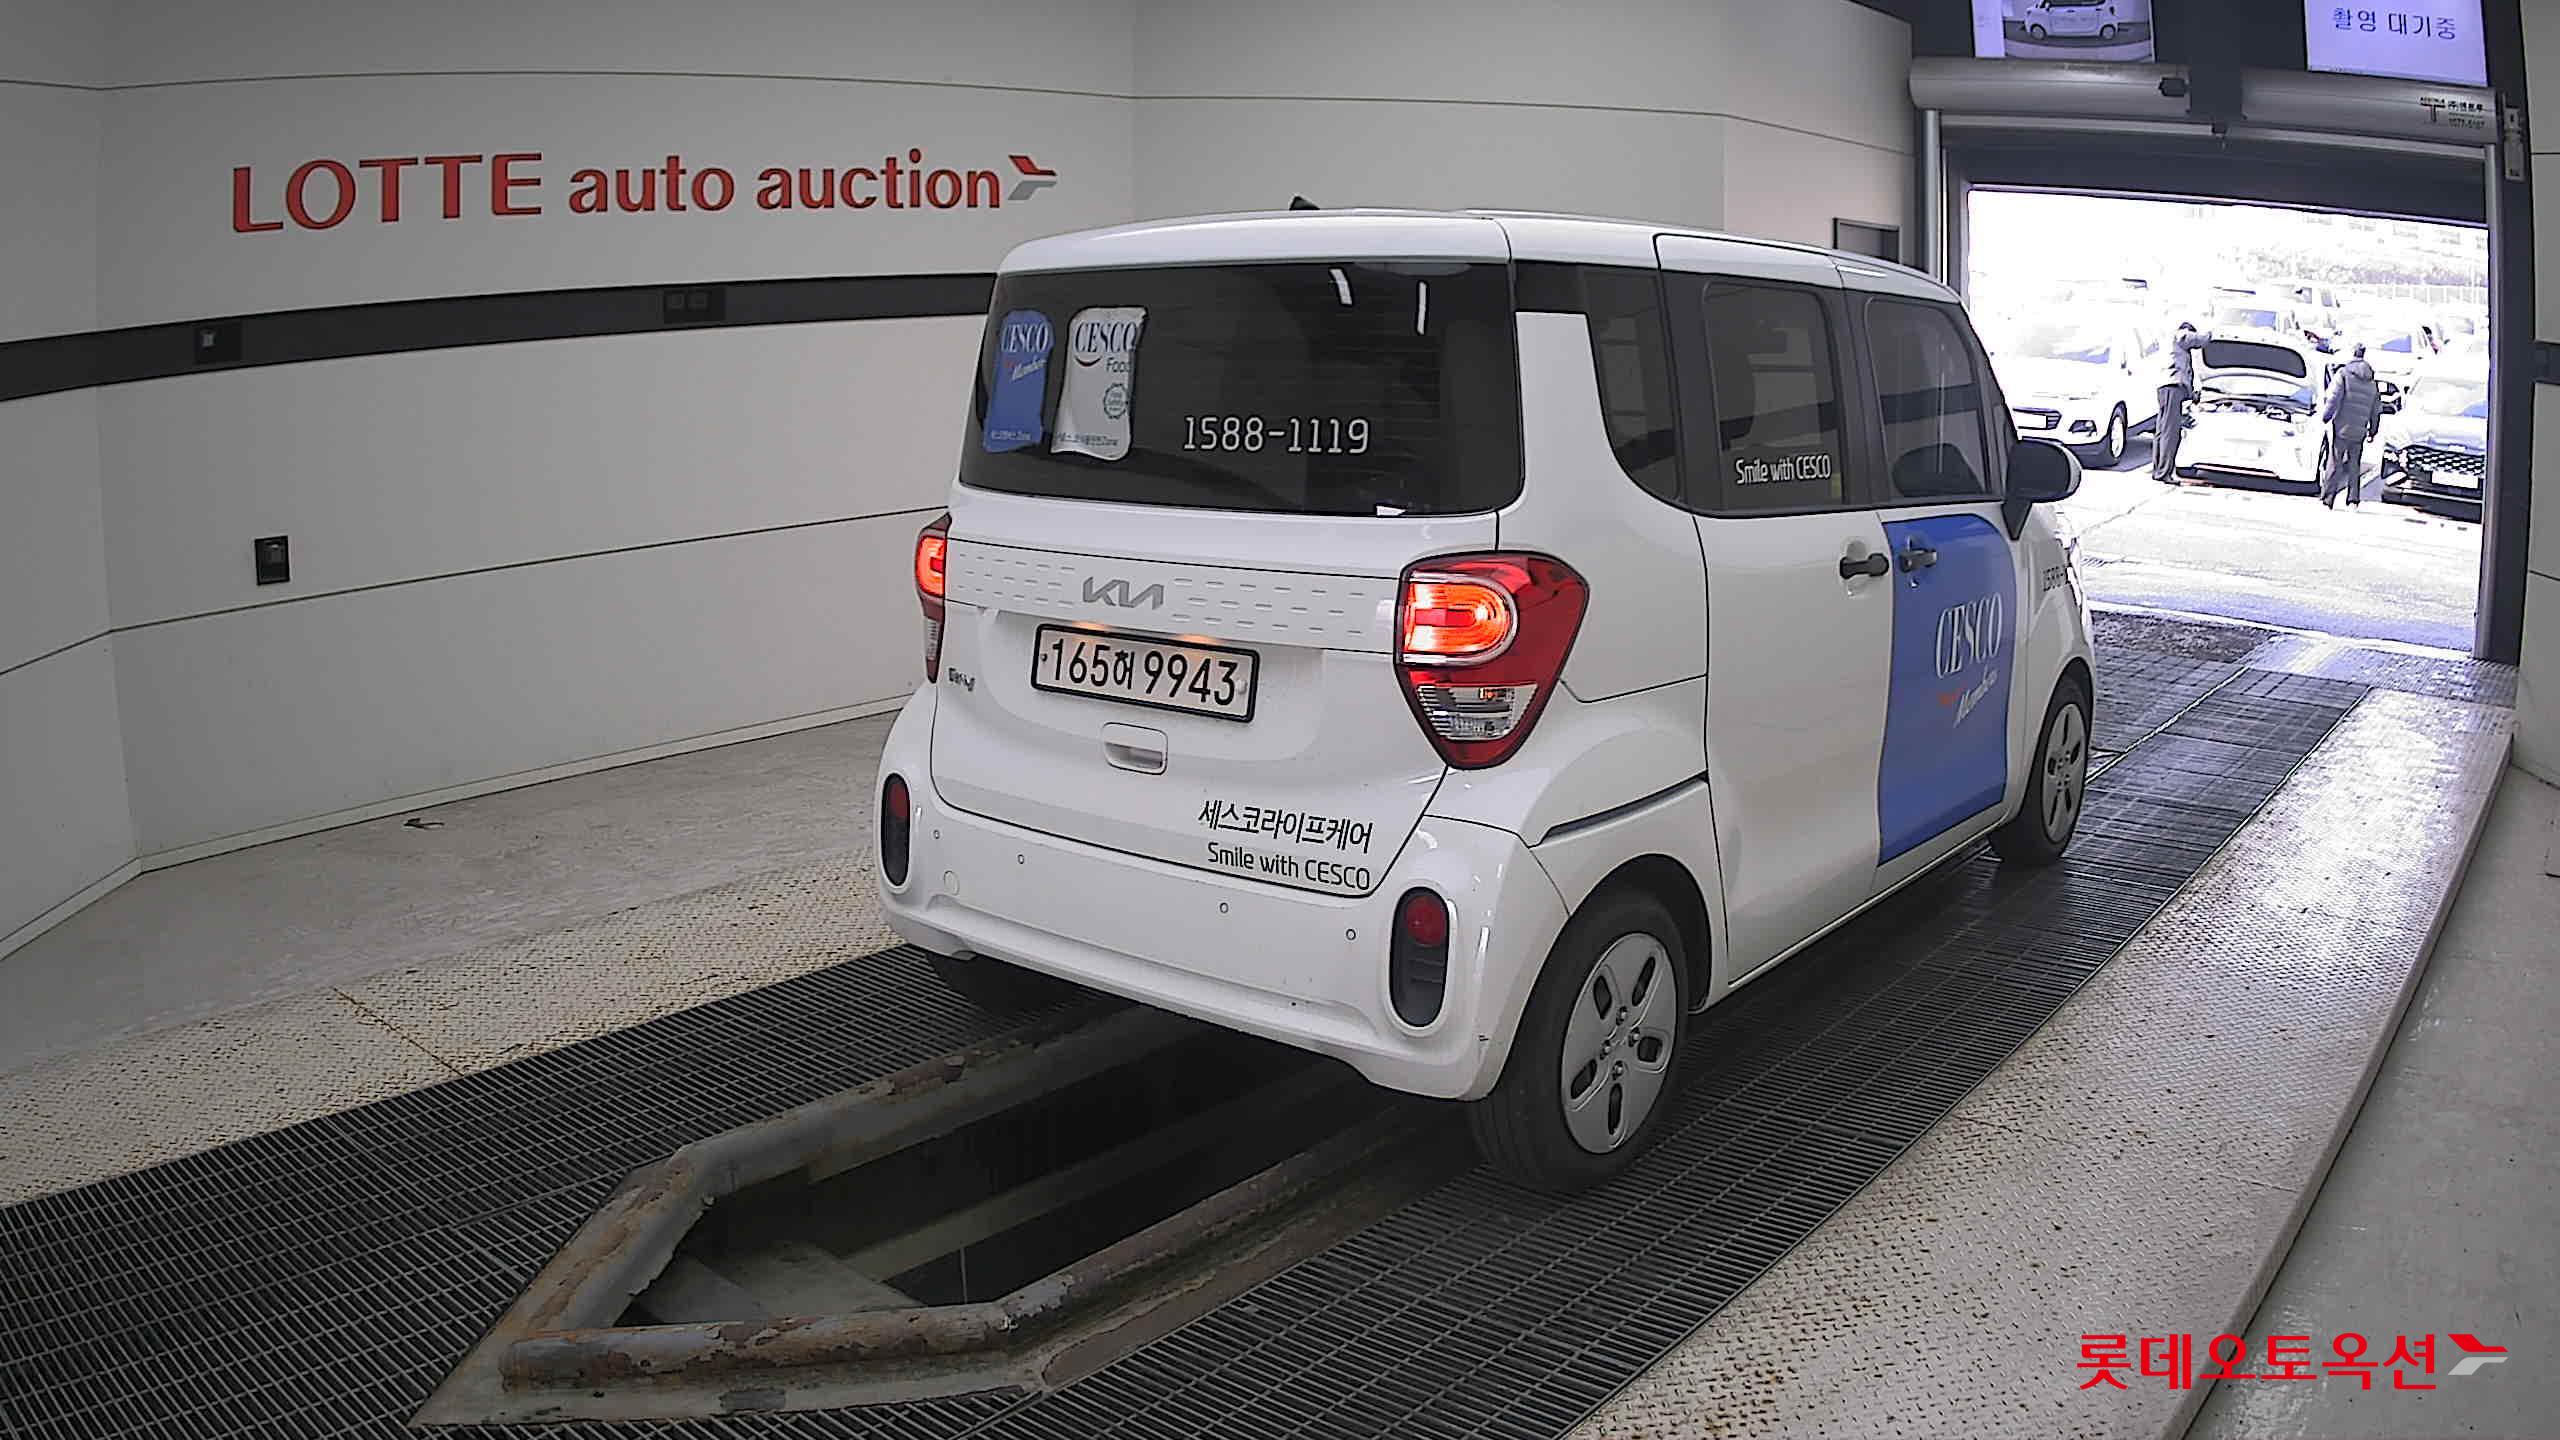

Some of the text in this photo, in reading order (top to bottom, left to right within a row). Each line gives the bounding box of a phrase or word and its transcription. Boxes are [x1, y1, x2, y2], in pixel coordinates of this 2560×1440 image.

[2333, 7, 2456, 41] 촬영 대기중
[233, 148, 1001, 233] LOTTE auto auction
[1000, 322, 1049, 353] CESCO
[1074, 319, 1139, 354] CESCO
[1183, 415, 1370, 455] 1588-1119
[1736, 453, 1832, 485] Smile with CESCO
[1936, 592, 2003, 679] CESCO
[1143, 650, 1239, 706] 9943
[1198, 799, 1374, 854] 세스코라이프케어
[1208, 841, 1371, 891] Smile with CESCO
